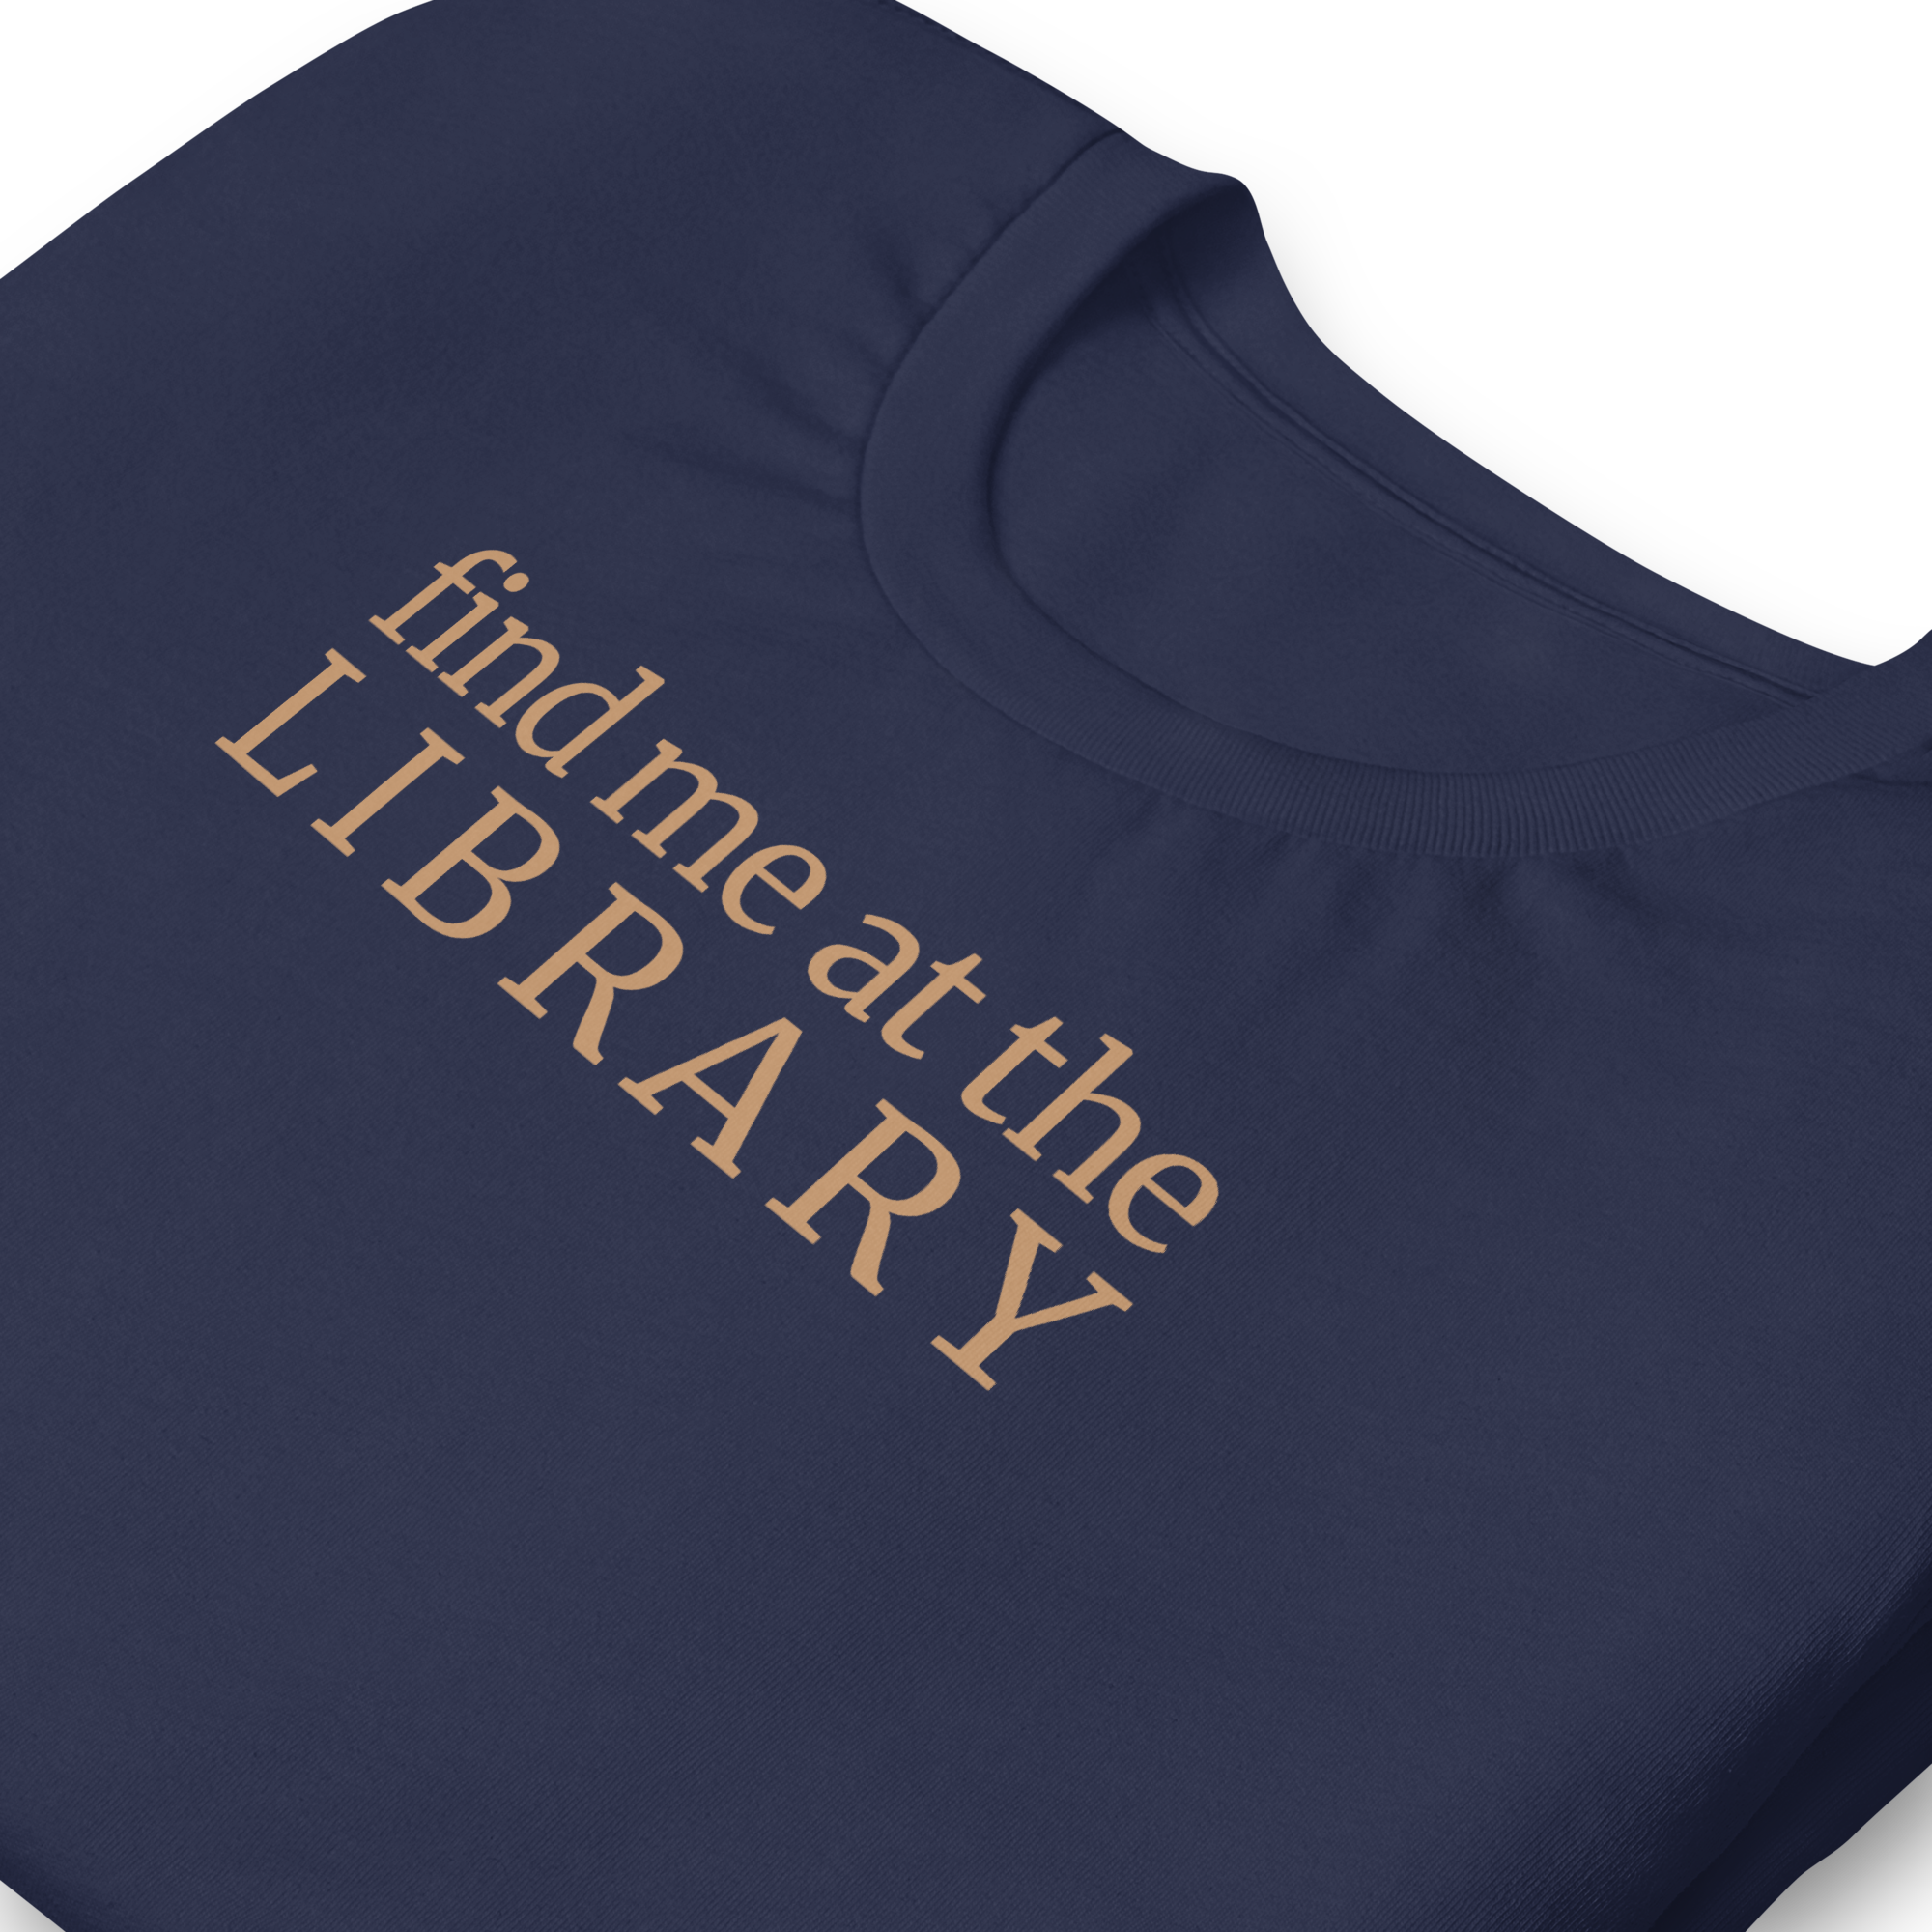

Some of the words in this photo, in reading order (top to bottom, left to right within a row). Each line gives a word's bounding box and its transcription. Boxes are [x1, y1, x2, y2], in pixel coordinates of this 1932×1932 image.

[215, 648, 1133, 1390] LIBRARY
[369, 550, 665, 778] find
[590, 739, 826, 935] me
[808, 914, 986, 1059] at
[961, 1017, 1218, 1253] the
